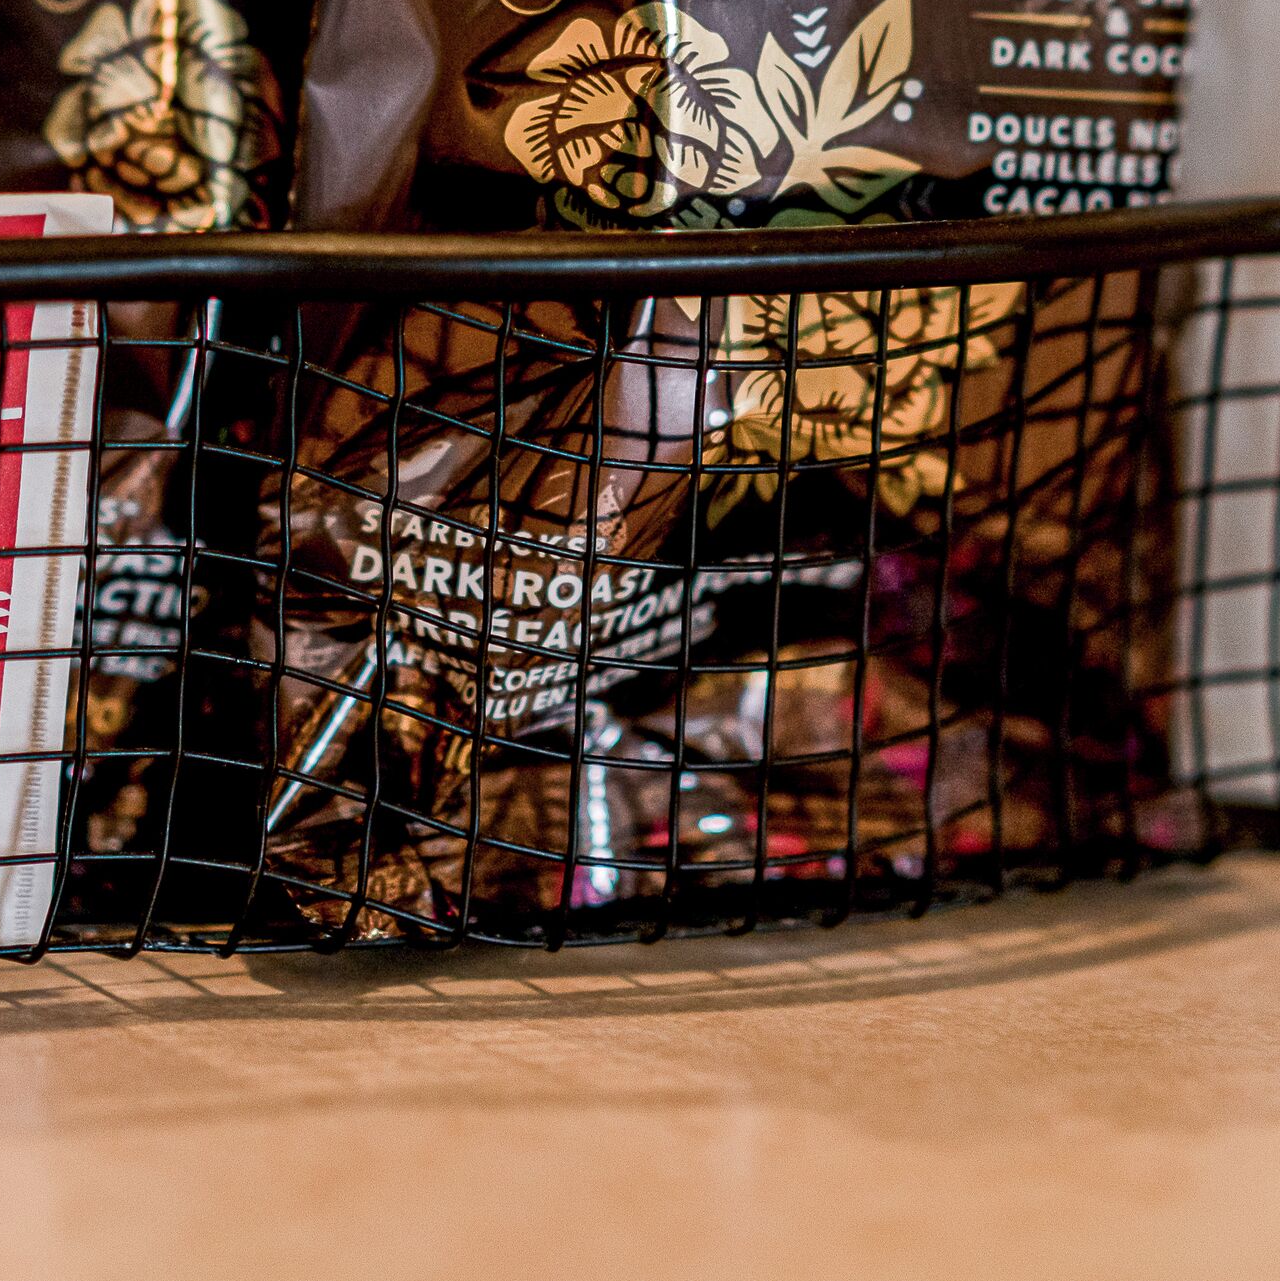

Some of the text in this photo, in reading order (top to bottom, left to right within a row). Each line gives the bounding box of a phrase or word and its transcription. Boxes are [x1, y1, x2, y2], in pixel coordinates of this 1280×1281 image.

[990, 37, 1092, 70] DARK
[969, 113, 1116, 149] DOUCES
[350, 544, 487, 601] DARK
[512, 567, 655, 609] ROAST
